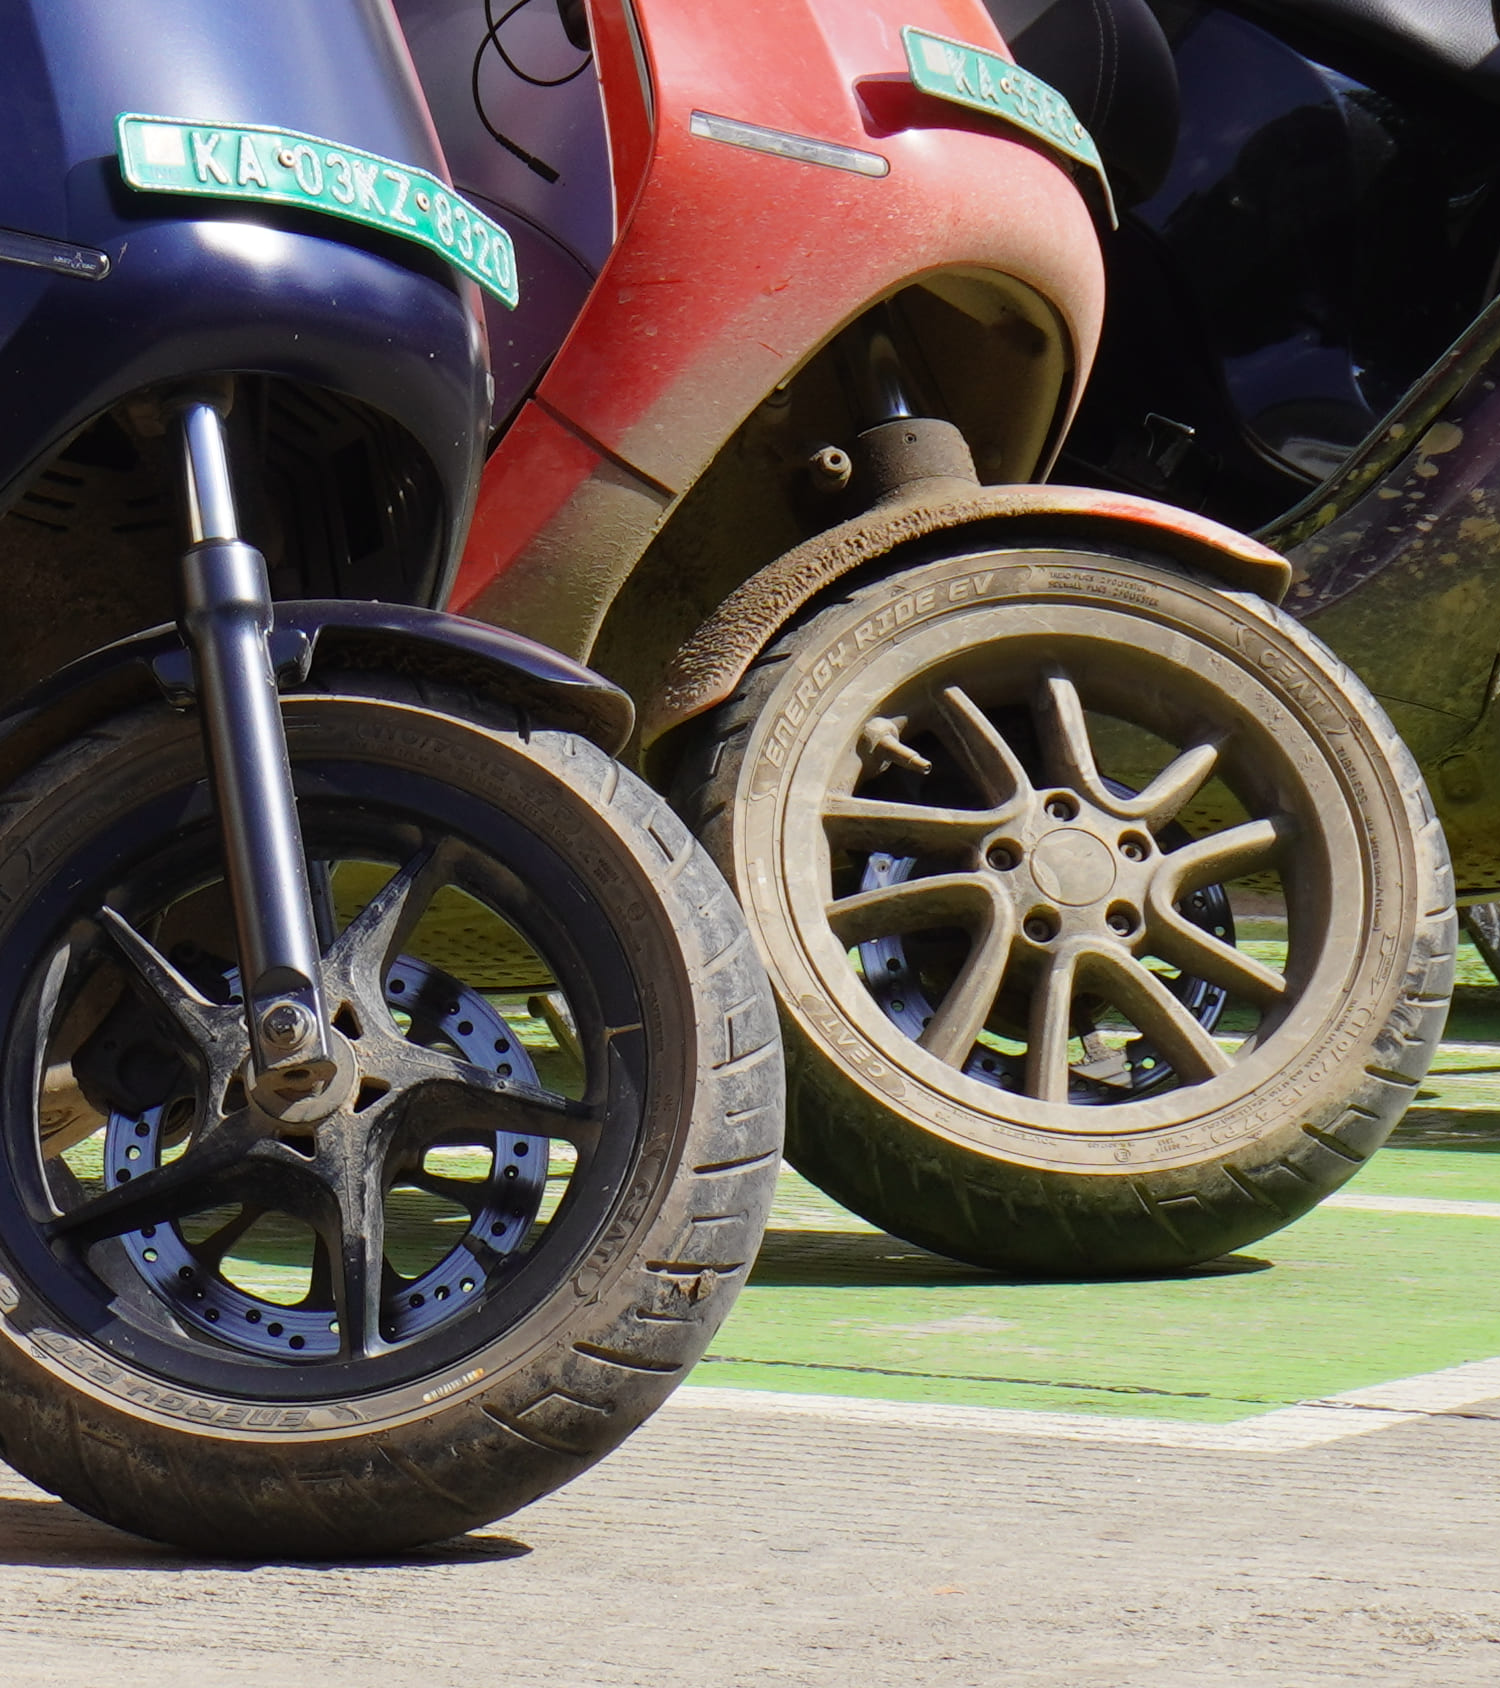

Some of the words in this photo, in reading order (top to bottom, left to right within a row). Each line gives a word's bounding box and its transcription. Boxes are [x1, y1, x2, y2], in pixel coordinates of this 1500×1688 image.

[190, 131, 267, 188] KA
[766, 640, 846, 769] ENERGY
[853, 587, 936, 651] RIDE
[948, 572, 995, 603] EV
[822, 1018, 886, 1078] CEAT
